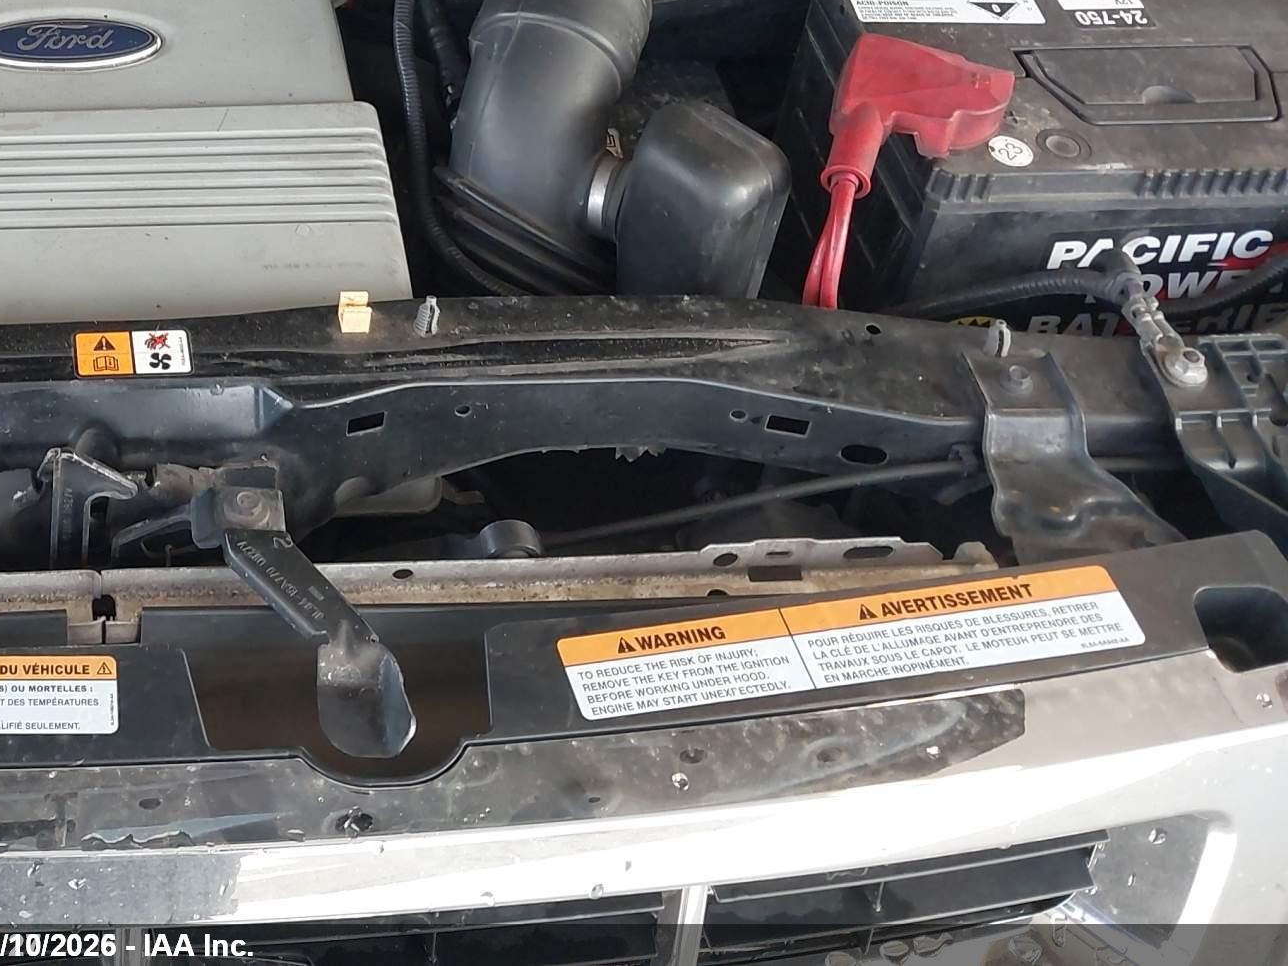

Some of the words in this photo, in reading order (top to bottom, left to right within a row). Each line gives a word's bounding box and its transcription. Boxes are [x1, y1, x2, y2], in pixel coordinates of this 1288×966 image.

[1074, 10, 1148, 26] 24-750
[17, 24, 114, 51] Ford
[880, 583, 1032, 618] AVERTISSEMENT
[634, 626, 726, 651] WARNING
[0, 663, 17, 676] DU
[22, 663, 89, 676] VÉHICULE
[576, 668, 594, 681] TO
[595, 662, 642, 678] REDUCE
[643, 659, 667, 672] THE
[668, 655, 695, 669] RISK
[697, 653, 713, 665] OF
[714, 647, 758, 663] INJURY;
[581, 676, 630, 692] REMOVE
[631, 672, 655, 686] THE
[657, 669, 680, 683] KEY
[681, 665, 715, 679] FROM
[715, 662, 739, 675] THE
[740, 655, 789, 672] IGNITION
[10, 684, 25, 693] OU
[28, 684, 87, 693] MORTELLES
[586, 687, 633, 704] BEFORE
[634, 680, 690, 698] WORKING
[691, 675, 732, 690] UNDER
[732, 670, 769, 685] HOOD.
[591, 701, 634, 717] ENGINE
[635, 698, 659, 711] MAY
[662, 693, 699, 707] START
